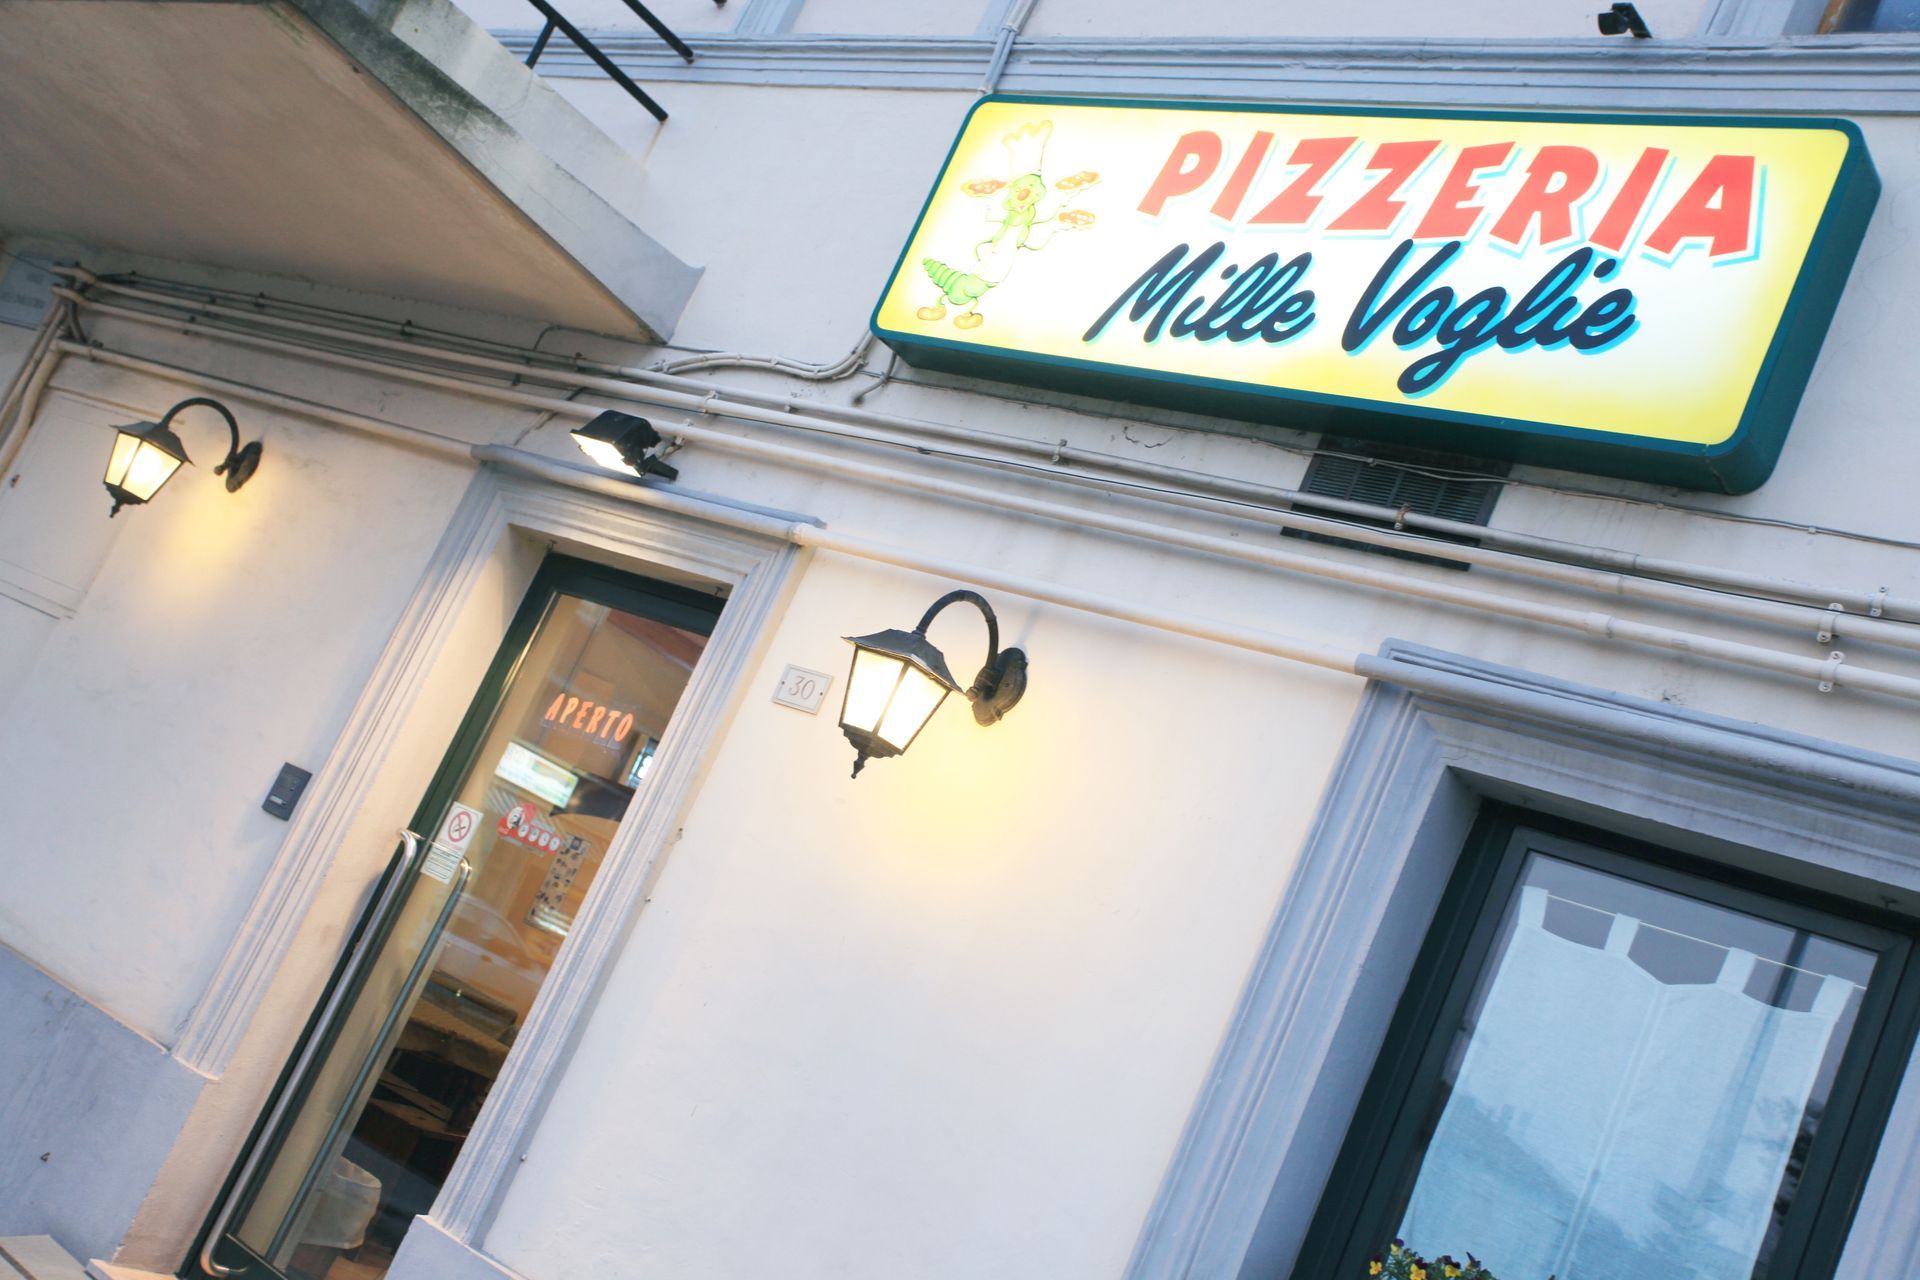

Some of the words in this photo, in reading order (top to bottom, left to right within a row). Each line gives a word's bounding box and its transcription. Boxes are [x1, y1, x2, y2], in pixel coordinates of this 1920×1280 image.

[1138, 131, 1757, 257] PIZZERIA
[1083, 241, 1315, 345] Mille
[1342, 238, 1637, 396] Voglie
[544, 692, 634, 742] APERTO
[788, 675, 816, 700] 30
